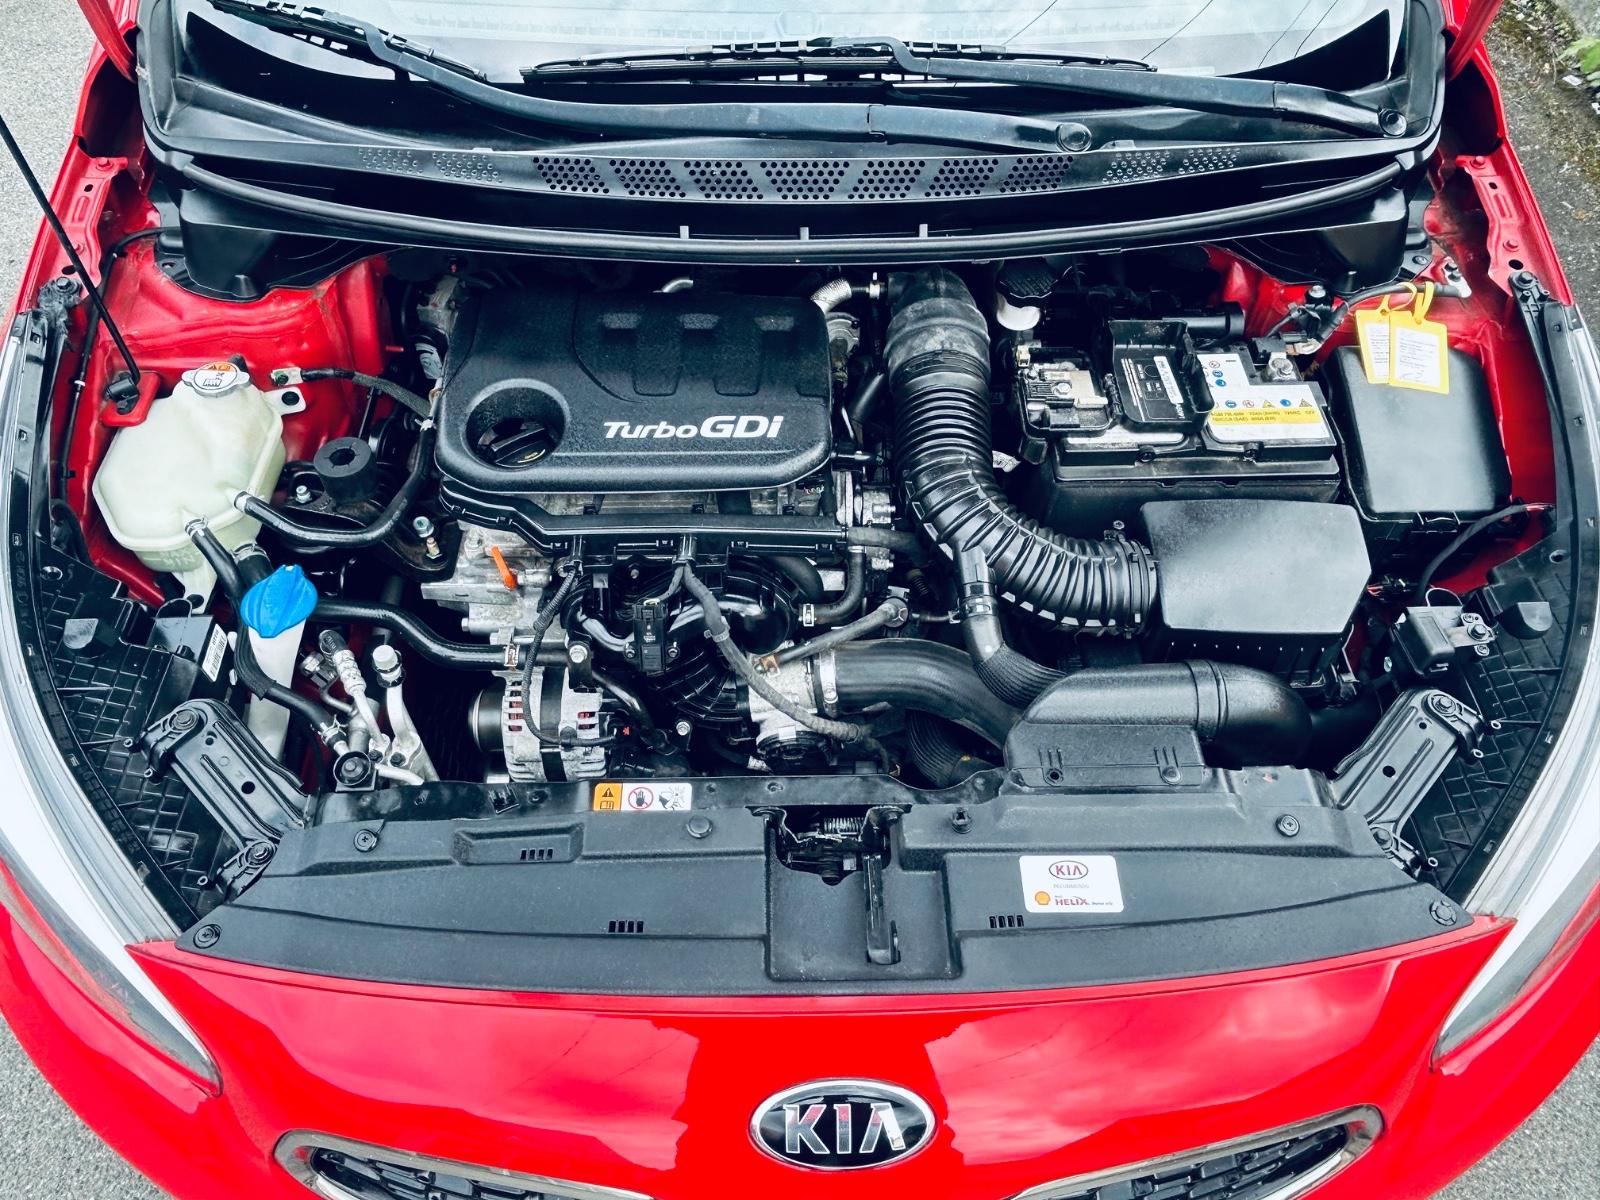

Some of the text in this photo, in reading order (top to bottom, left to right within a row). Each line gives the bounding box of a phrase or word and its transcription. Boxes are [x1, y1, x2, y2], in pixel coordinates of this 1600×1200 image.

[1055, 864, 1083, 876] KIA
[1055, 897, 1088, 906] HELIX
[783, 1103, 906, 1154] KIA
